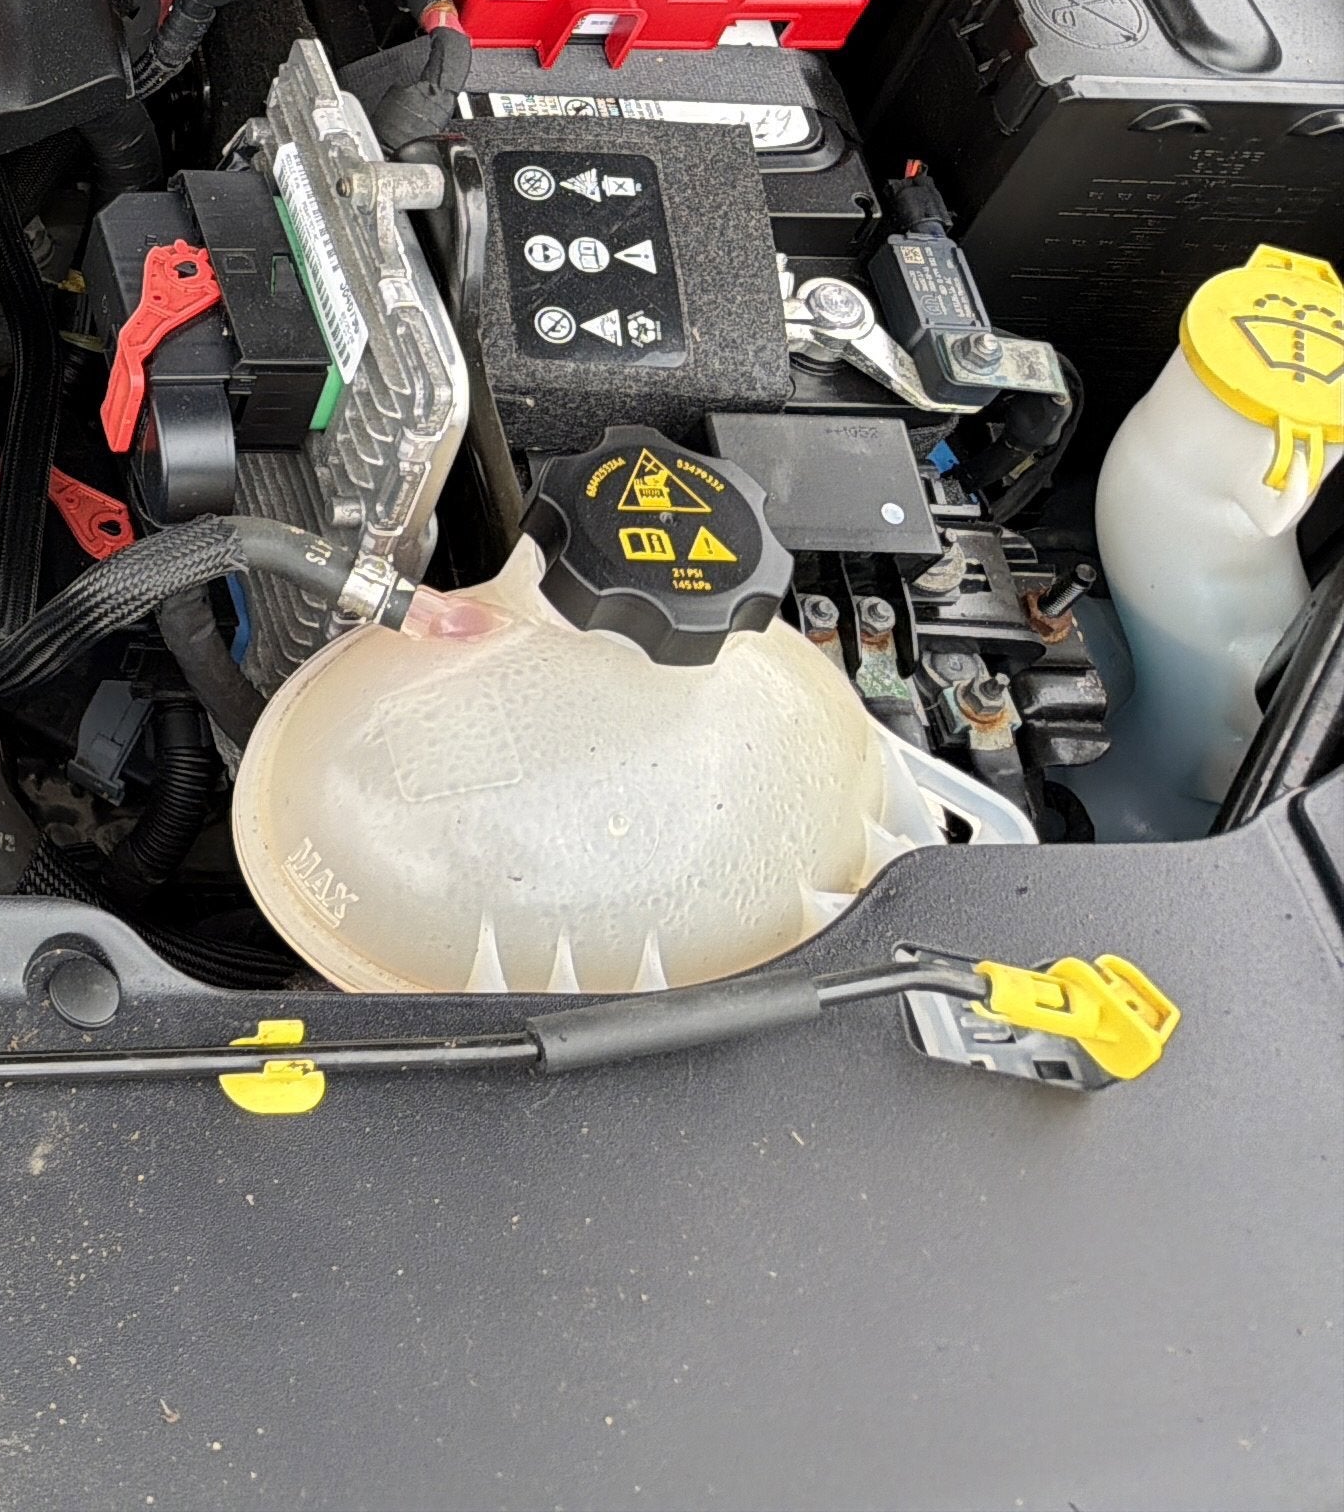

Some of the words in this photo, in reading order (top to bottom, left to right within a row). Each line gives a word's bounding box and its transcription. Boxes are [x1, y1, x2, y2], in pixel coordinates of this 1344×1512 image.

[676, 458, 726, 493] 53479332
[672, 567, 686, 578] 21
[687, 568, 703, 578] PSI
[672, 580, 693, 590] 145
[287, 836, 359, 920] MAX
